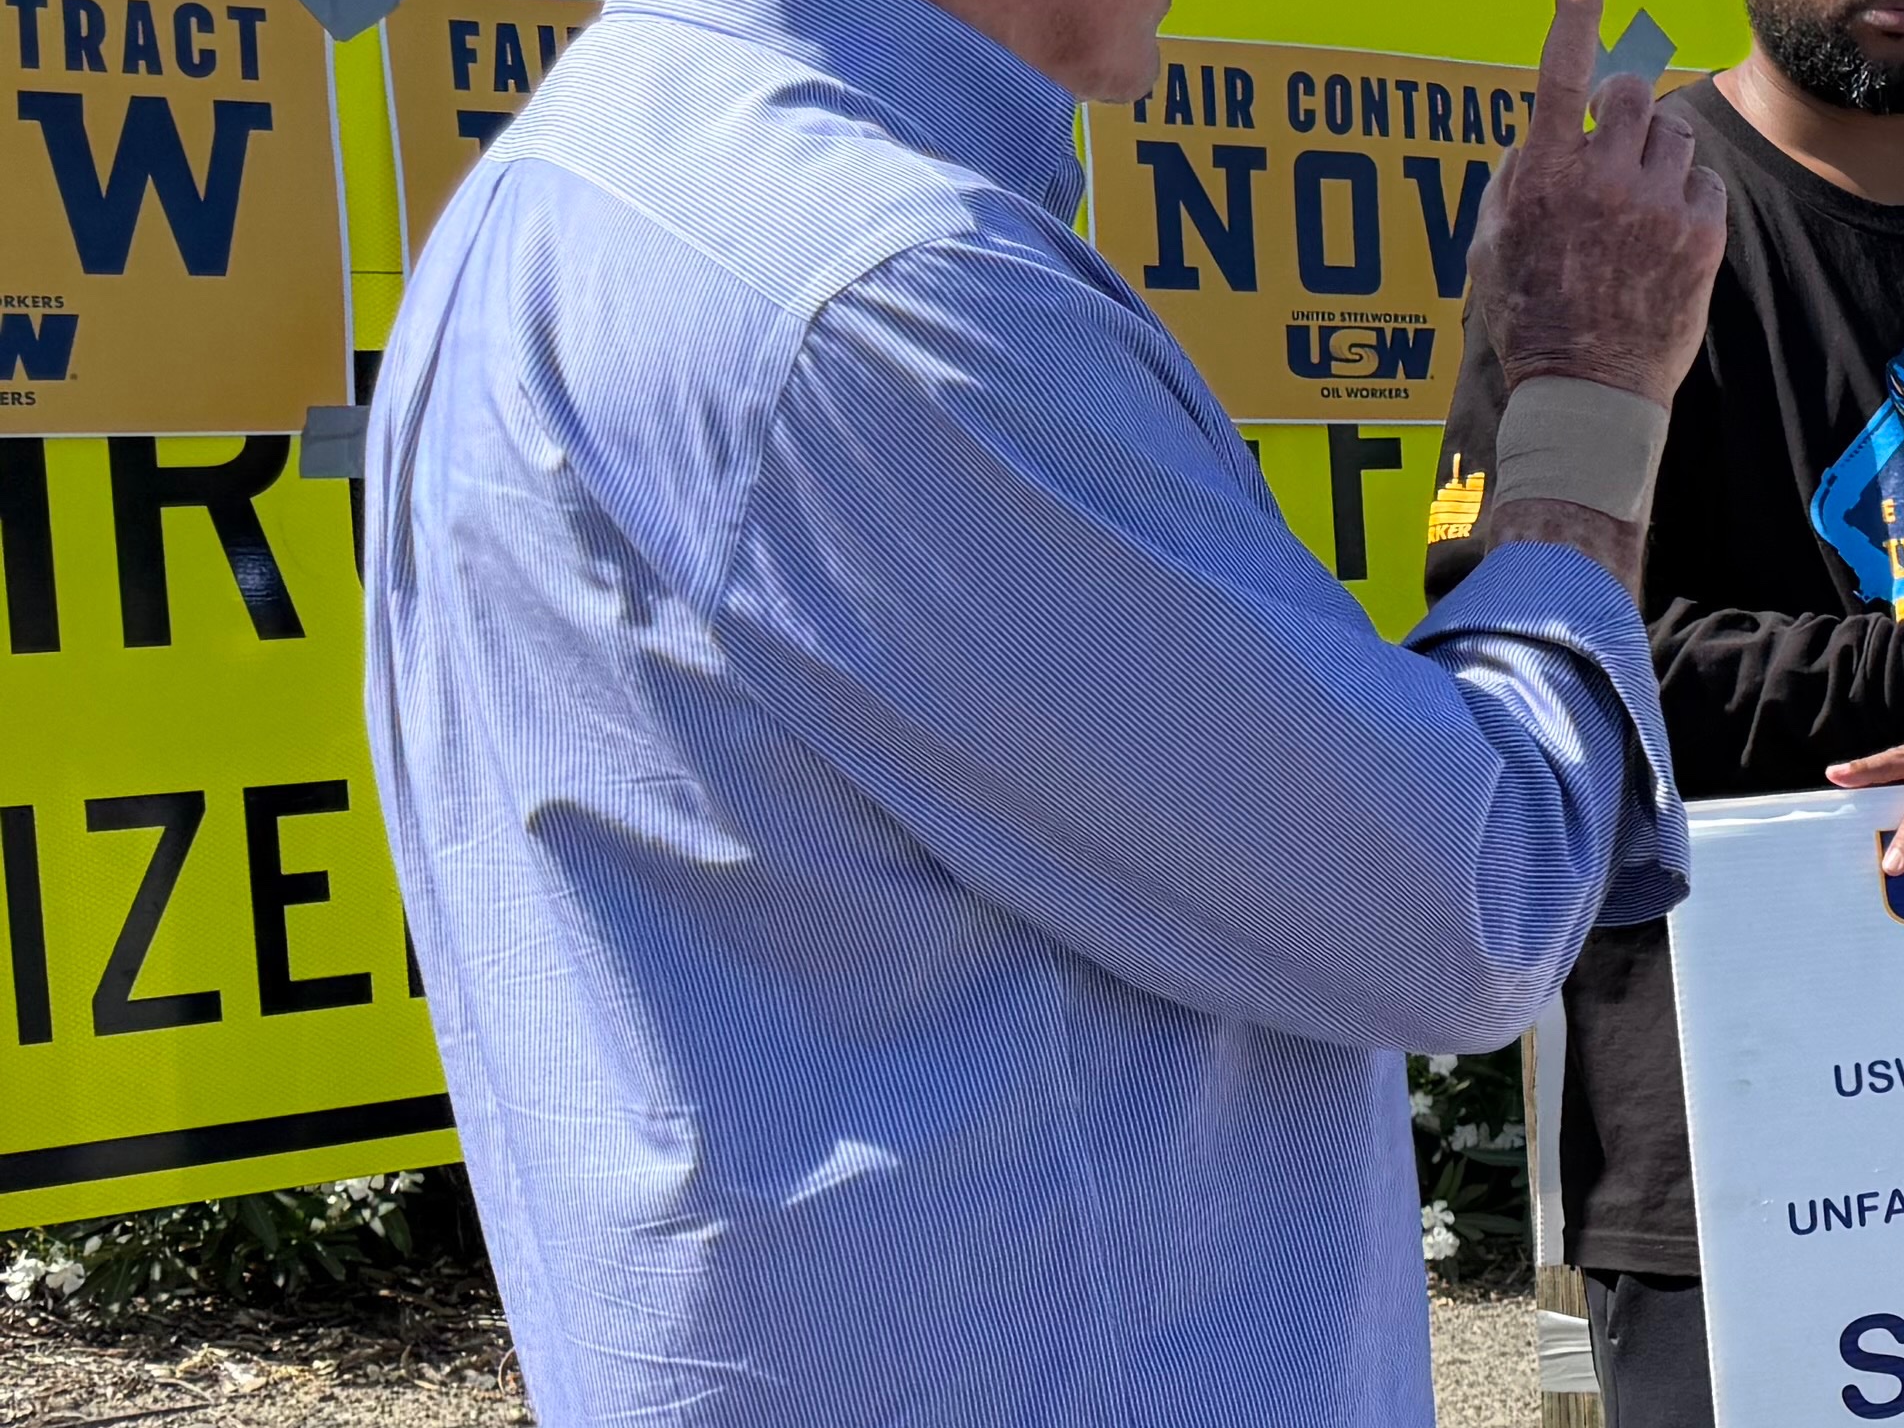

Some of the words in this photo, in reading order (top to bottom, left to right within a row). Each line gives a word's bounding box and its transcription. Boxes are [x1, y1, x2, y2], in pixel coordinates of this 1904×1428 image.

[1290, 309, 1336, 323] UNITED
[1339, 311, 1428, 325] STEELWORKERS
[1285, 325, 1437, 380] USW
[1320, 386, 1343, 400] OIL
[1345, 386, 1410, 400] WORKERS
